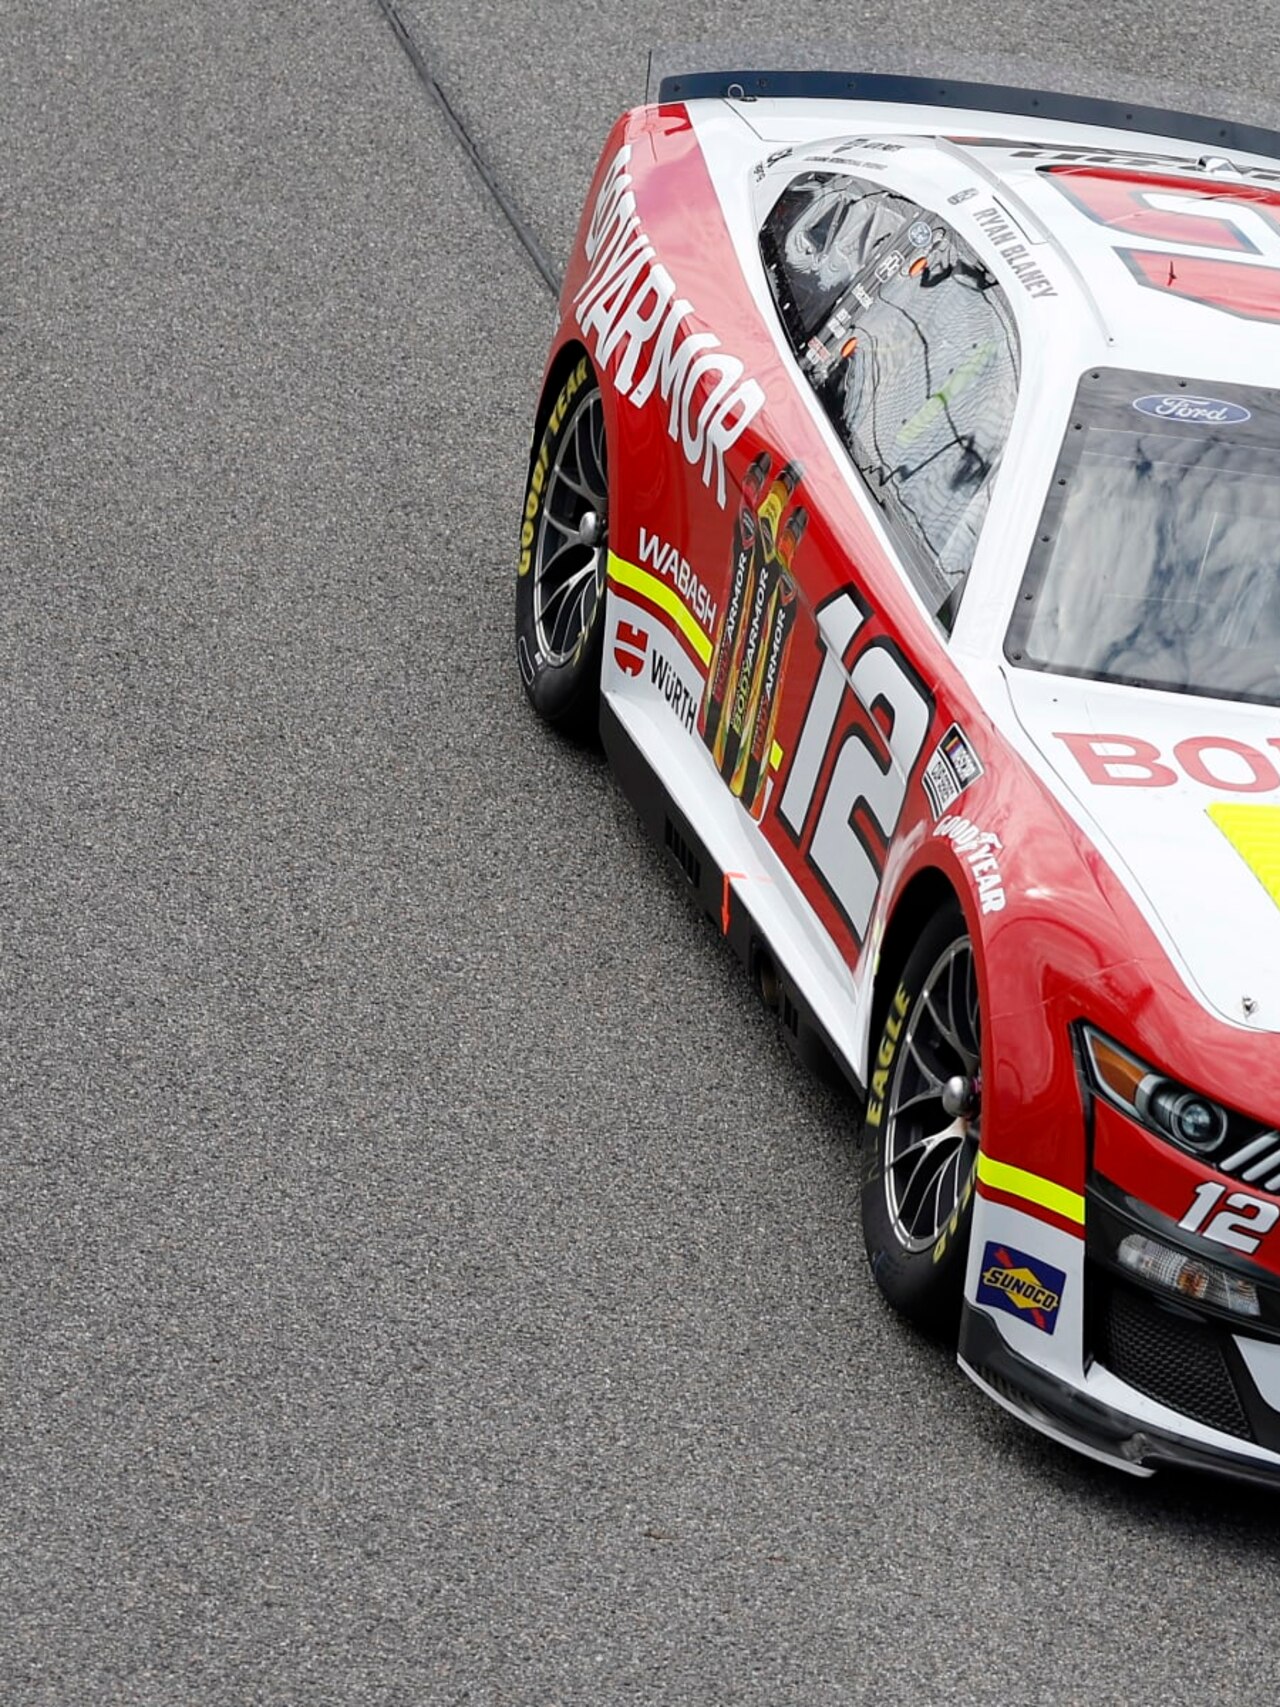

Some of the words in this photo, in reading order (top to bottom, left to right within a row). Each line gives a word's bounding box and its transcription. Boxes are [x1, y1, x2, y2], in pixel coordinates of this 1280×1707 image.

[972, 206, 1017, 247] RYAN
[1000, 243, 1059, 300] BLANEY
[1155, 397, 1228, 421] Ford
[637, 526, 718, 634] WABASH
[650, 648, 698, 736] WÜRTH
[732, 567, 770, 737] BODYARMOR
[777, 584, 936, 945] 12
[933, 813, 1007, 915] GOODYEAR
[865, 984, 911, 1128] EAGLE
[1177, 1181, 1280, 1255] 12
[984, 1266, 1059, 1310] SUNOCO
